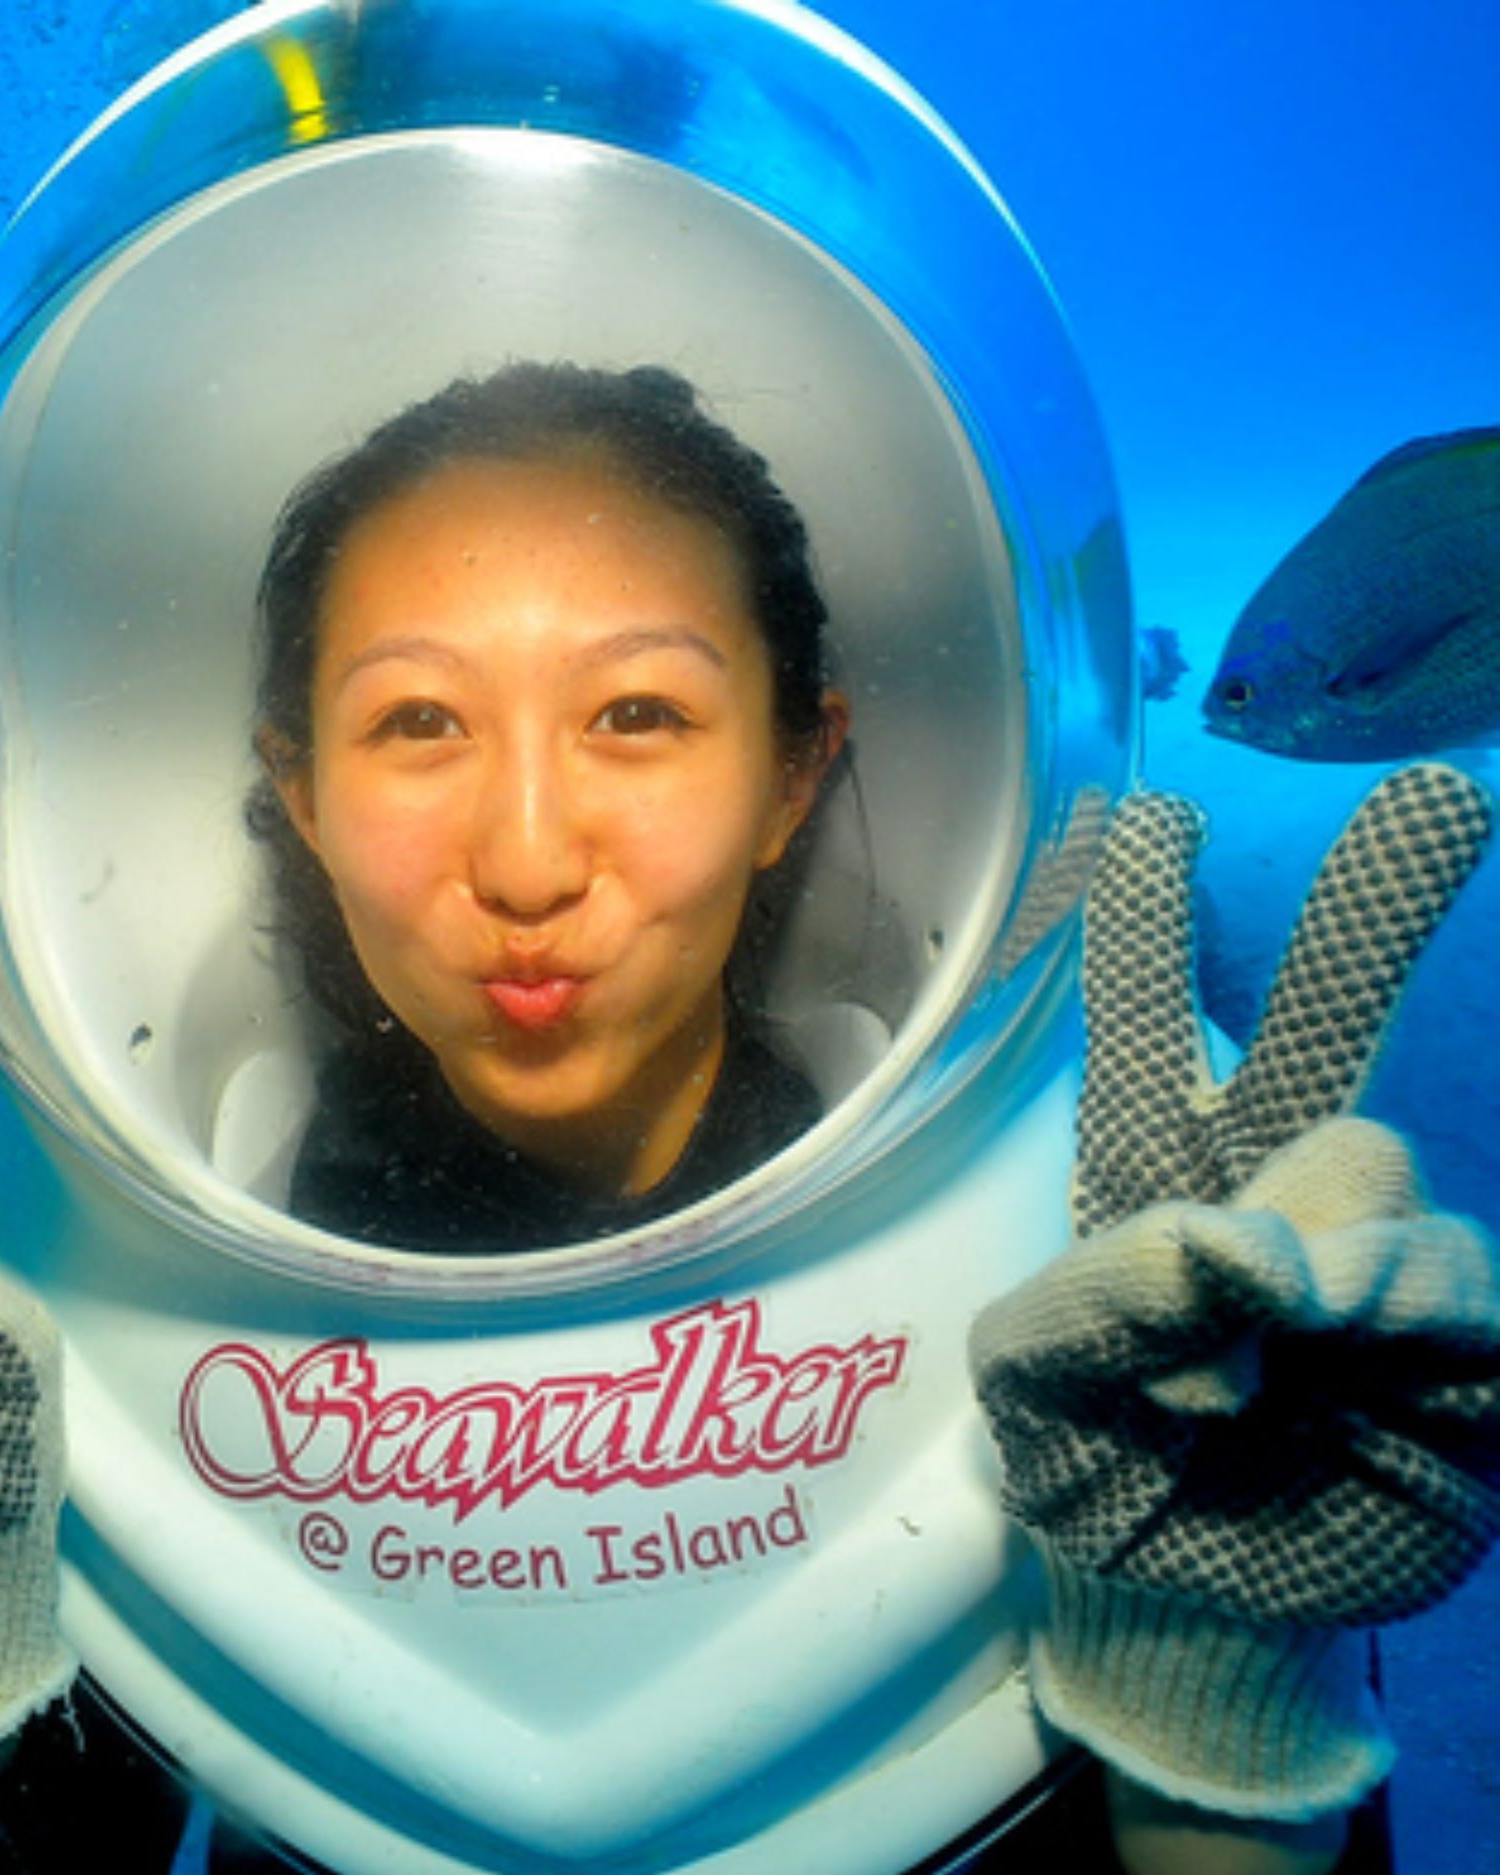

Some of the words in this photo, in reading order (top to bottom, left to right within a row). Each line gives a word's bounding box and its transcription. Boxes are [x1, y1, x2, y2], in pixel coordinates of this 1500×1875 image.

[180, 1298, 907, 1523] Seawalker
[299, 1512, 349, 1571] @
[371, 1525, 567, 1590] Green
[587, 1486, 808, 1584] Island
